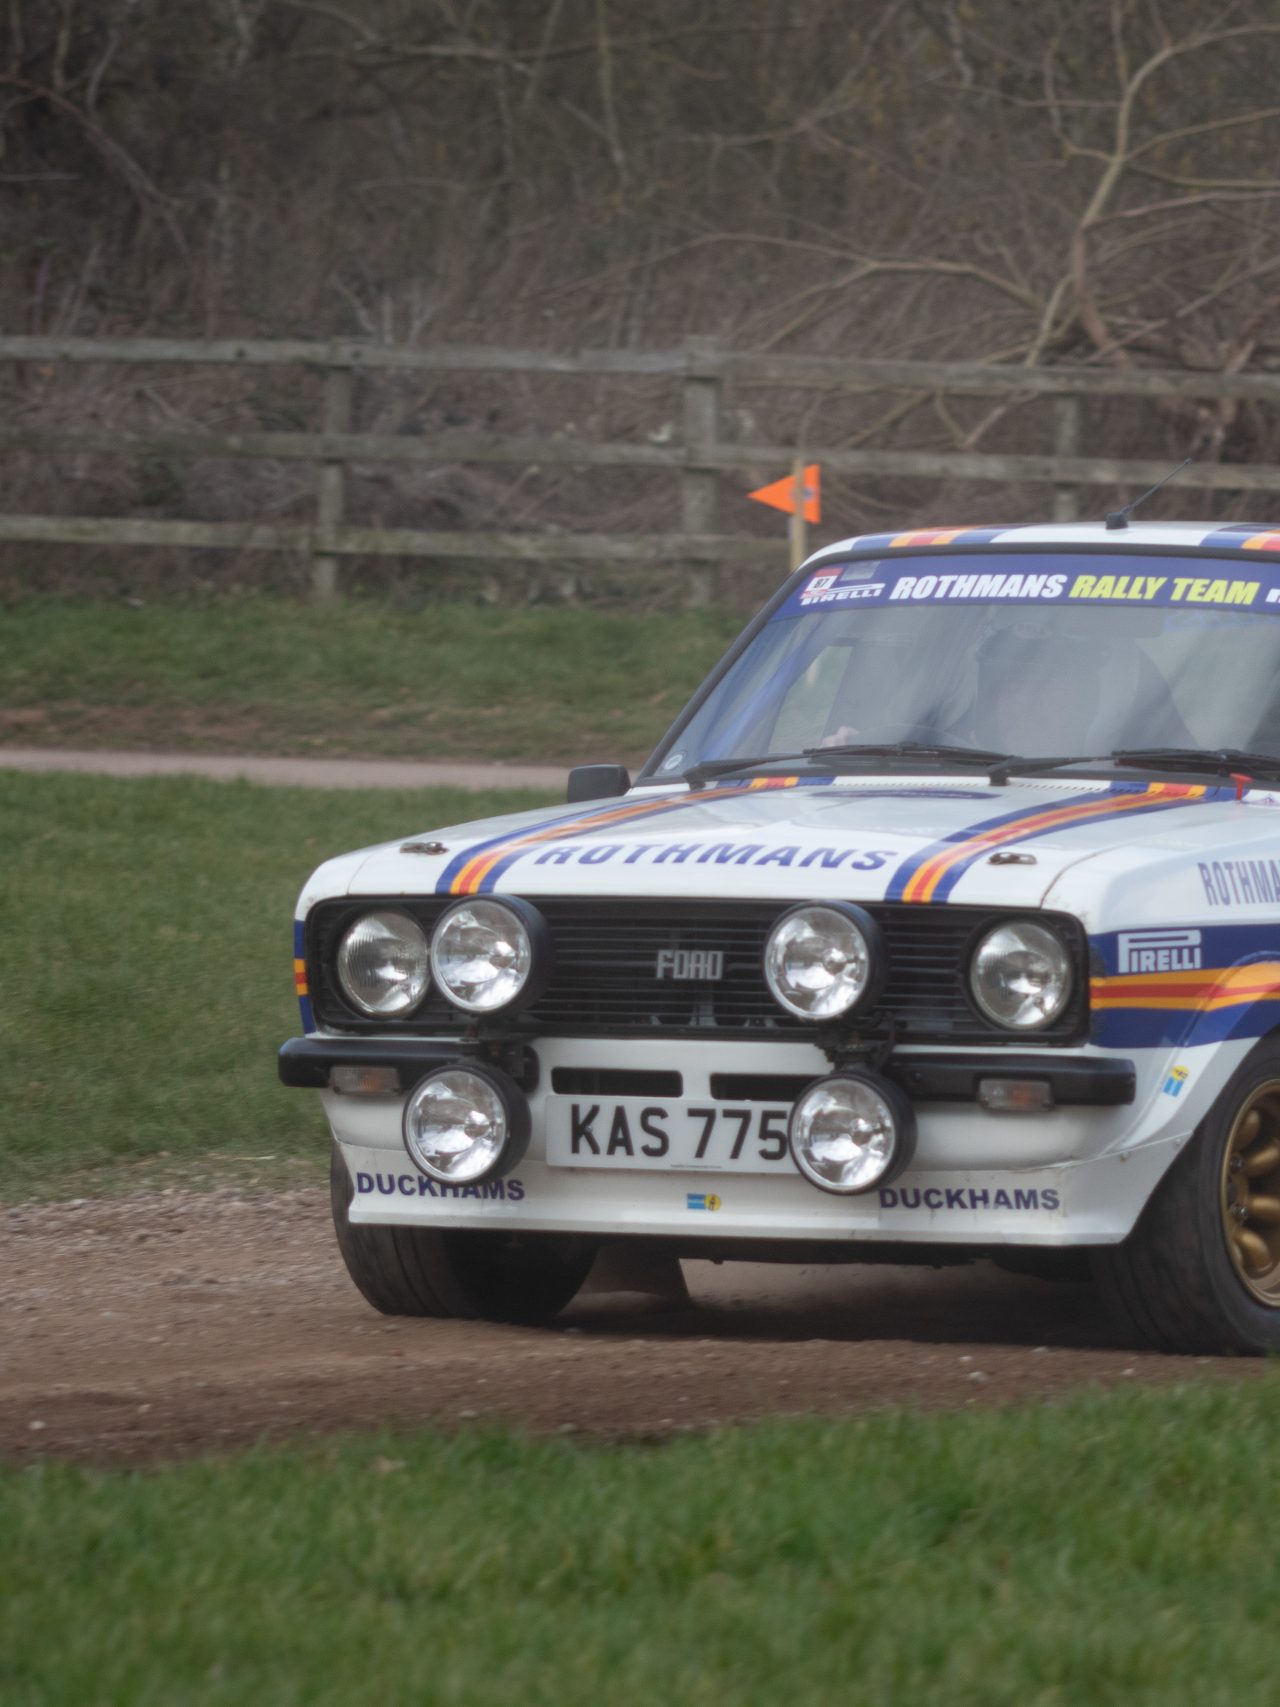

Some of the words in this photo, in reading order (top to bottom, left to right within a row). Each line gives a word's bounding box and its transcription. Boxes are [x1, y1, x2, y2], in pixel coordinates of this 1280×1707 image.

[889, 574, 1067, 600] ROTHMANS
[1069, 575, 1167, 600] RALLY
[1170, 577, 1260, 605] TEAM
[533, 842, 897, 871] ROTHMANS
[656, 949, 724, 980] FORD
[1118, 930, 1202, 974] PIRELLI
[571, 1103, 670, 1158] KAS
[687, 1107, 788, 1161] 775
[879, 1187, 1060, 1211] DUCKHAMS
